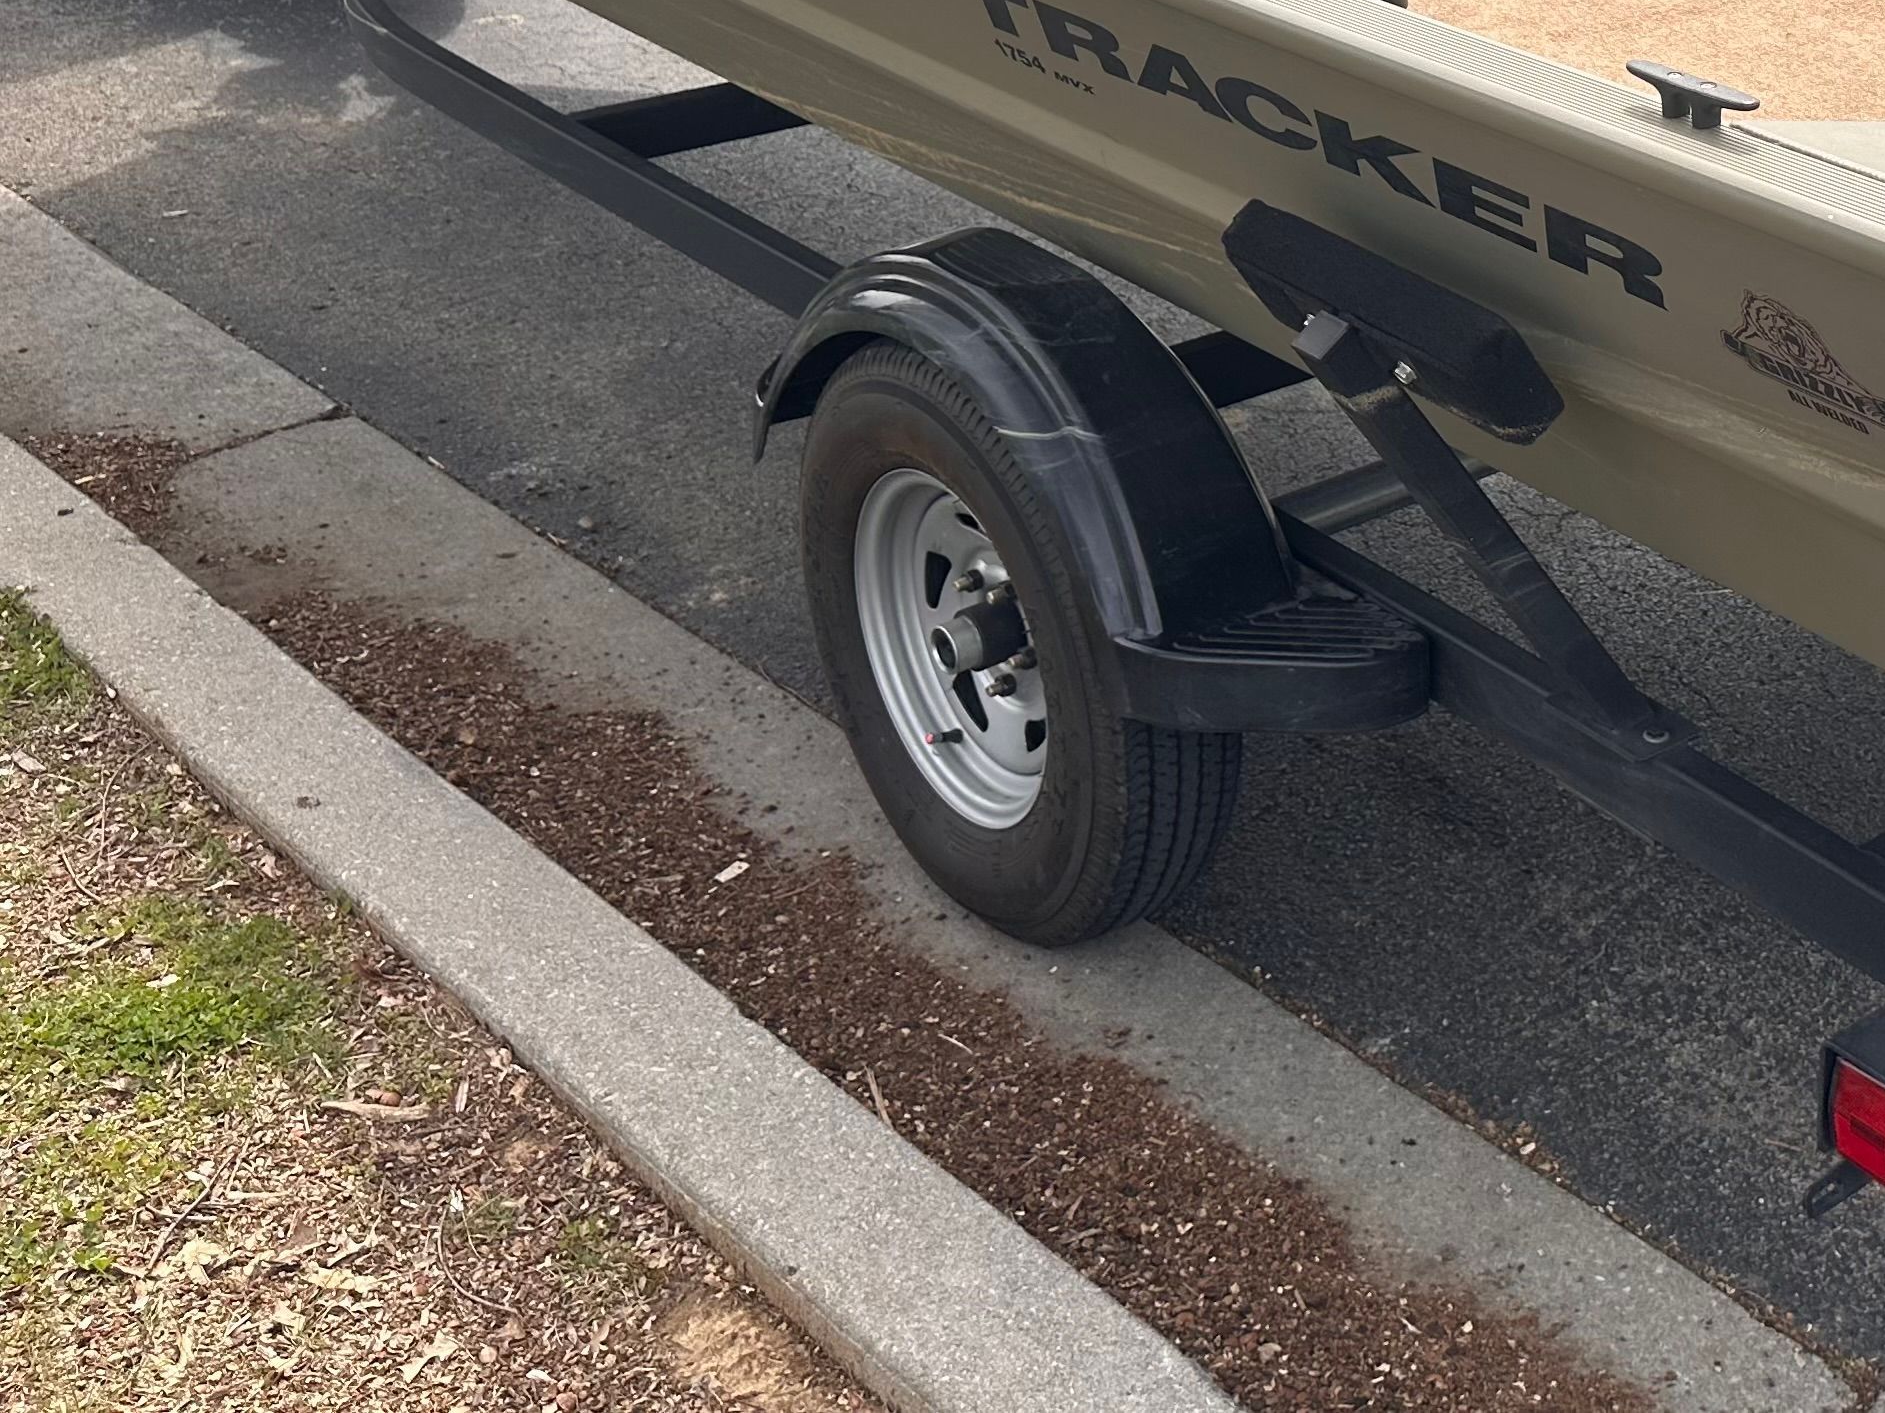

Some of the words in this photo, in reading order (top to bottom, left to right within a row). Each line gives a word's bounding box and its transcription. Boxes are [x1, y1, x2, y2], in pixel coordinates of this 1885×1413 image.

[993, 38, 1047, 74] 1754
[1054, 71, 1095, 95] MVX
[1752, 352, 1868, 416] GRIZZLY
[1786, 388, 1812, 410] ALL
[1810, 398, 1870, 435] WELDED
